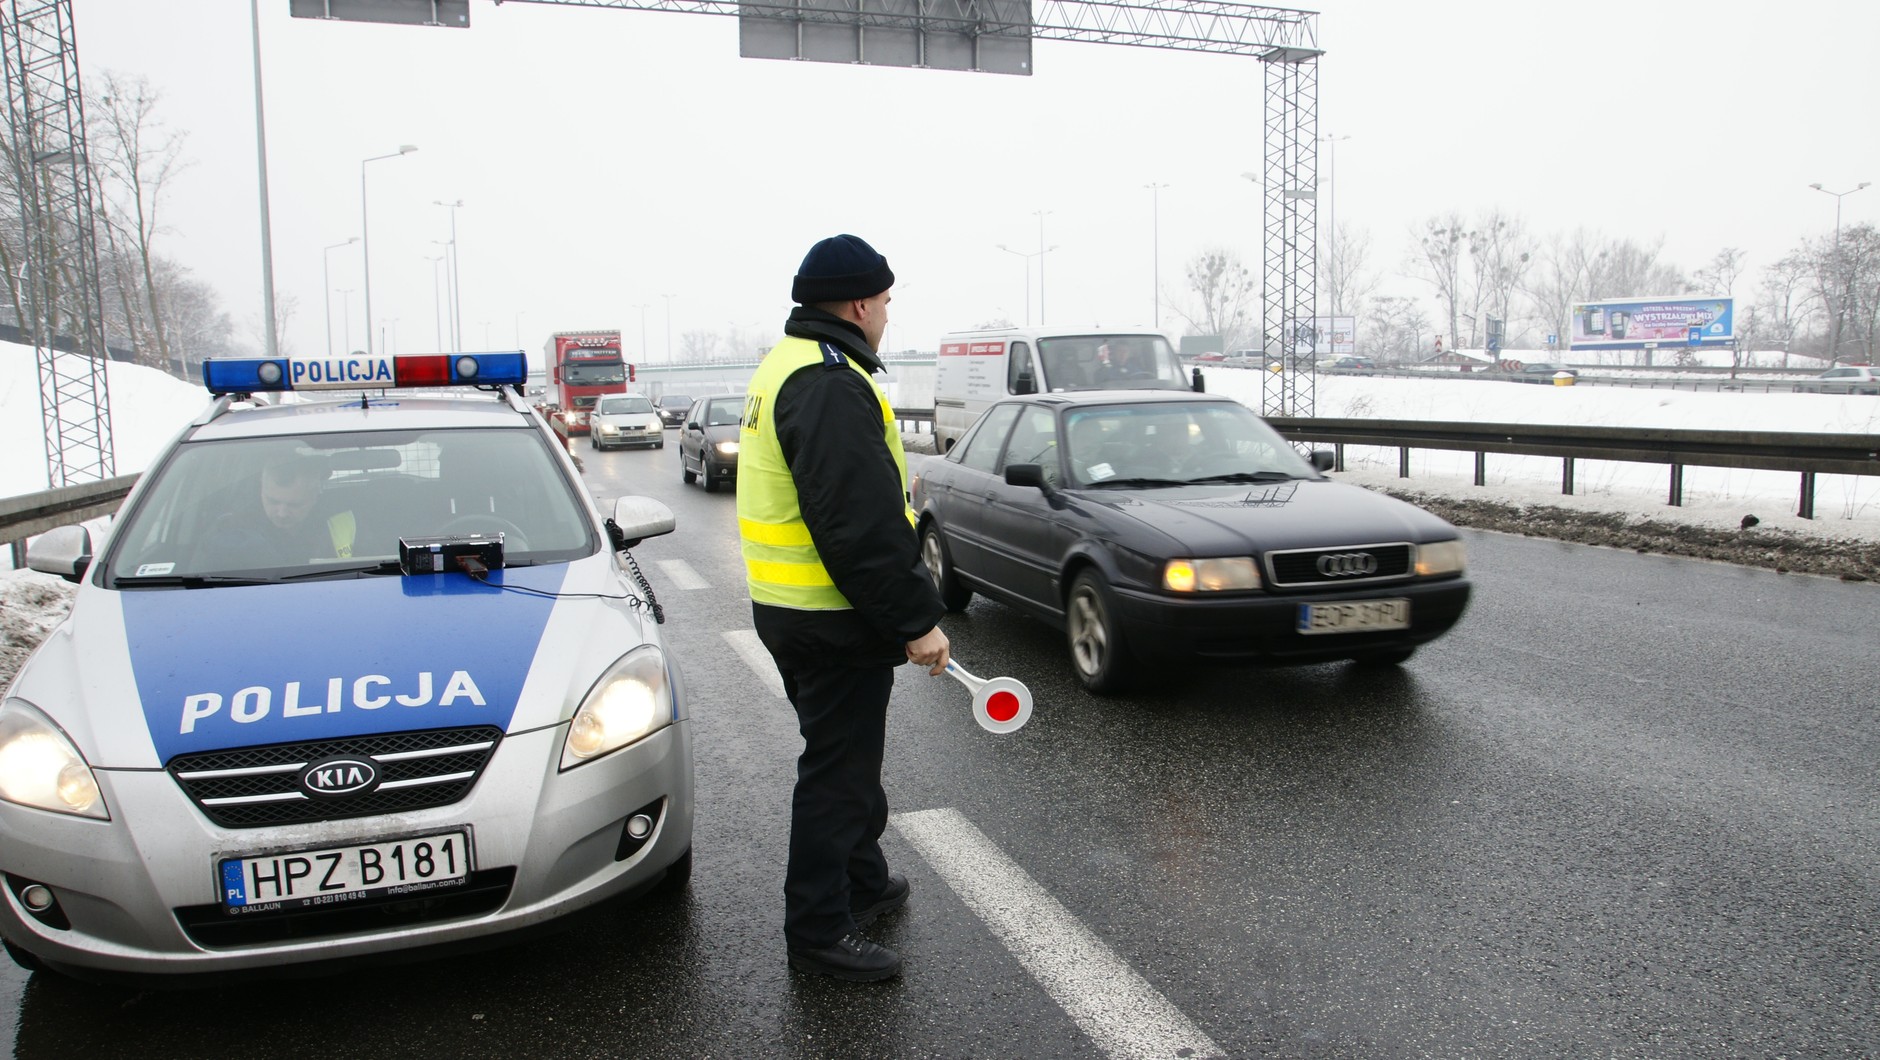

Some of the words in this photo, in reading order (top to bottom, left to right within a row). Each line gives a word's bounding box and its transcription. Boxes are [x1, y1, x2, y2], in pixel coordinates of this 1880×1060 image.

[292, 359, 392, 383] POLICJA
[180, 670, 487, 734] POLICJA
[316, 768, 365, 788] KIA
[251, 852, 346, 899] HPZ
[358, 838, 456, 885] B181
[228, 888, 243, 900] PL
[387, 876, 466, 895] info@ballaun.com.pl
[334, 893, 347, 902] 810
[348, 891, 357, 900] 49
[357, 890, 367, 898] 45
[242, 902, 281, 913] BALLAUN
